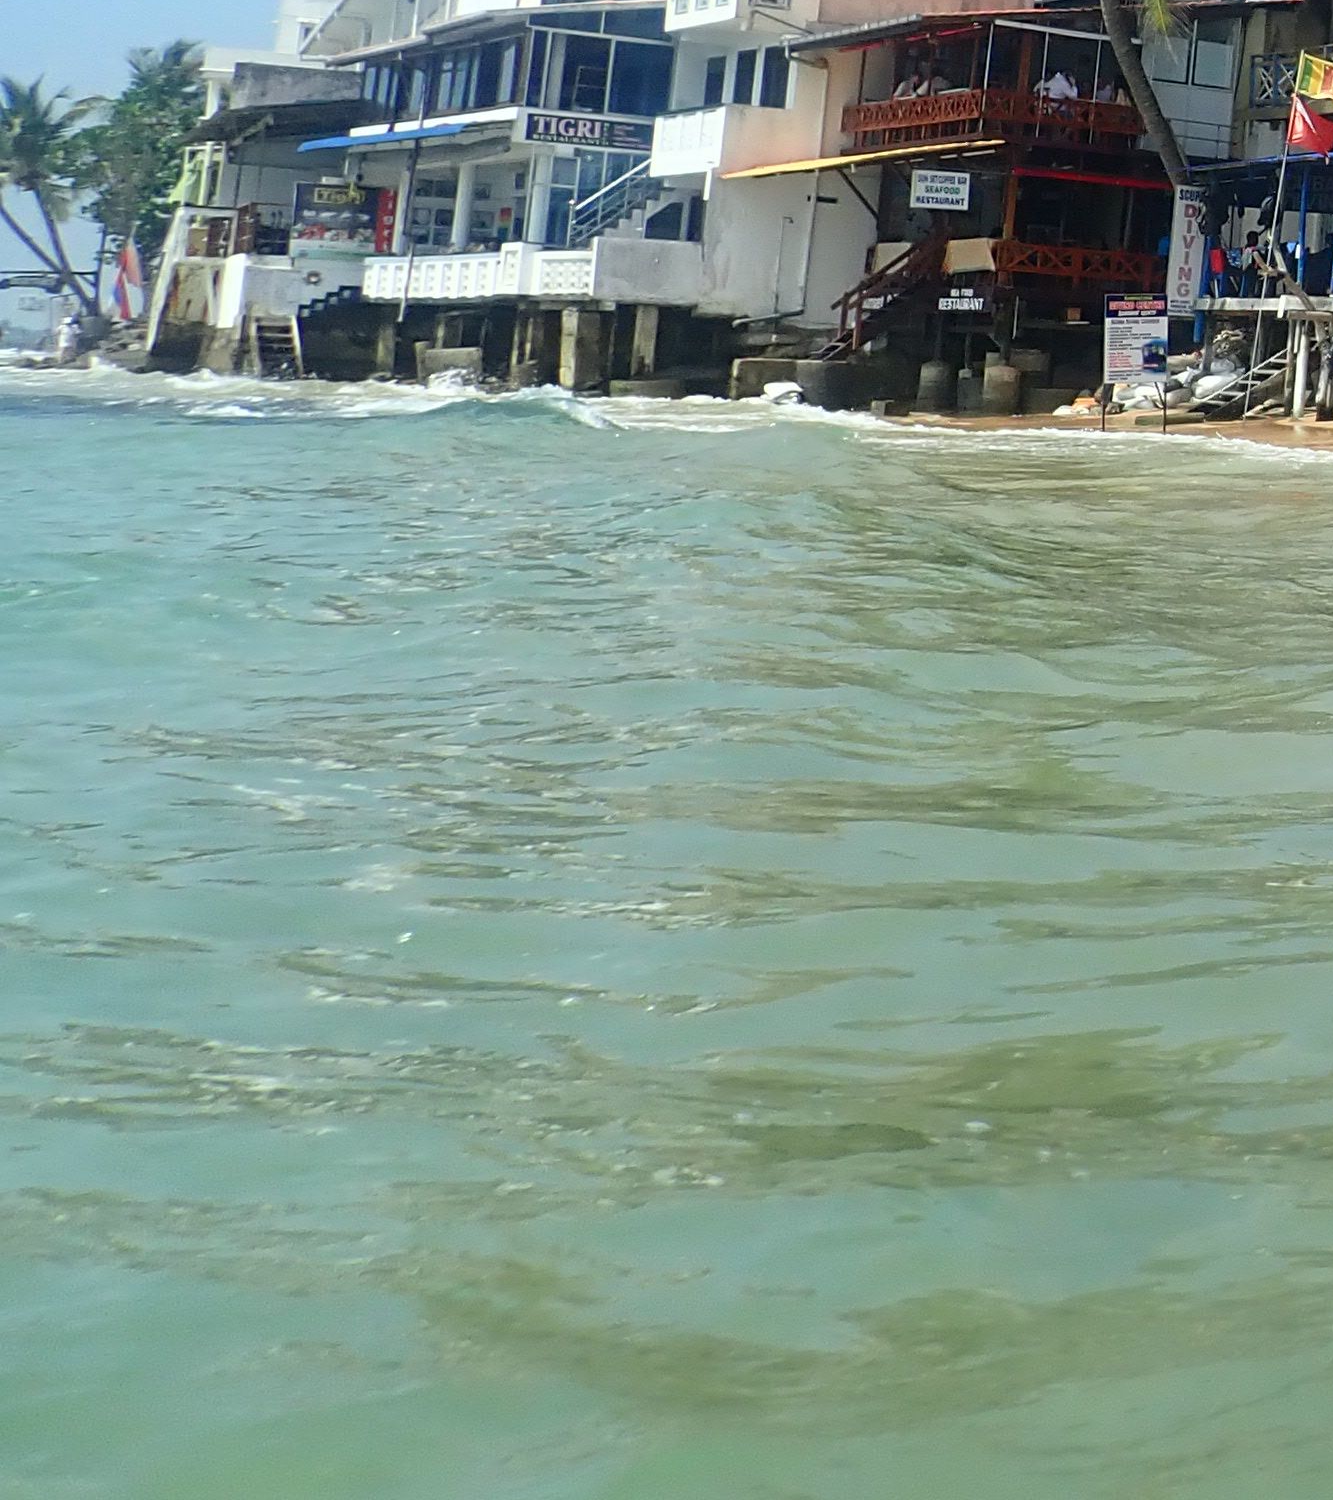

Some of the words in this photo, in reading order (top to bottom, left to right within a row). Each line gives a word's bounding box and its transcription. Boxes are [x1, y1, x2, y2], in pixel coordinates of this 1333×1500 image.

[533, 116, 602, 139] TIGRI
[924, 185, 961, 195] SEAFOOD
[1176, 204, 1198, 297] DIVING
